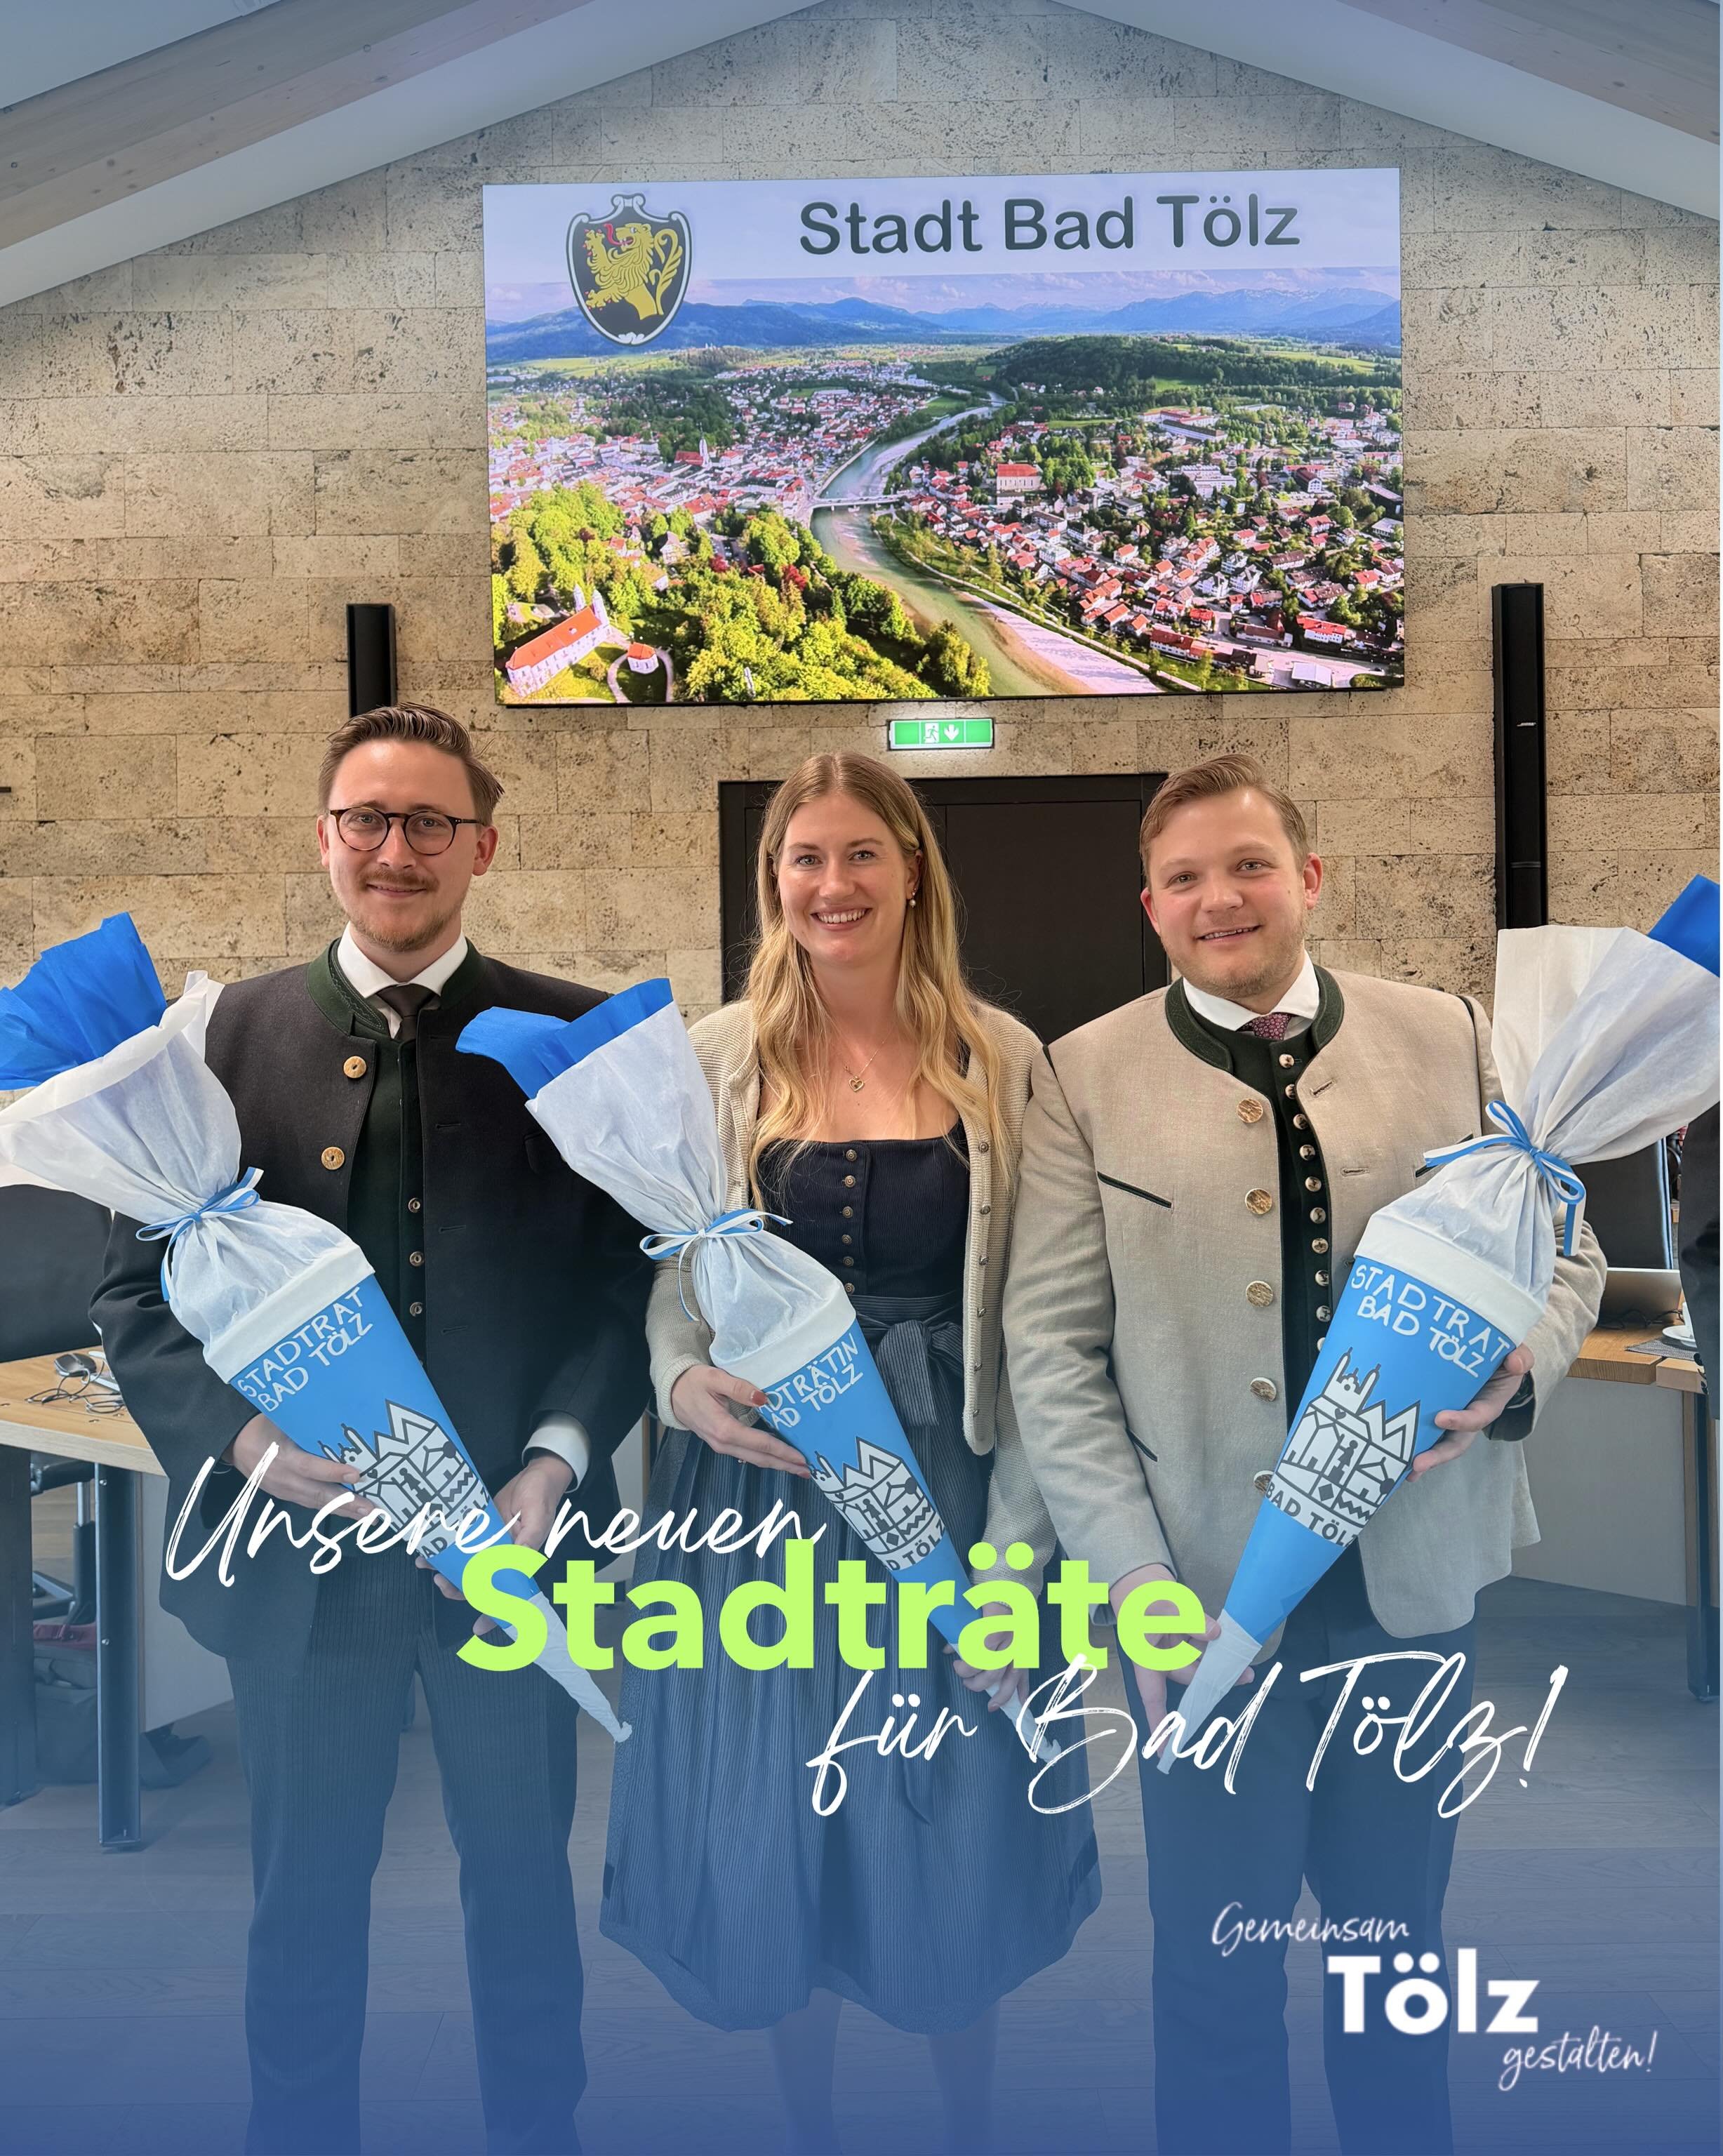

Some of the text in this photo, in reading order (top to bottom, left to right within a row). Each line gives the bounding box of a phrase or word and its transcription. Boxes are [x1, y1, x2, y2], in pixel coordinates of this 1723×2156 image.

[799, 193, 1300, 255] Stadt Bad Tölz
[237, 1286, 364, 1397] STADTRAT
[1351, 1264, 1510, 1363] STADTRAT
[1357, 1296, 1486, 1378] BAD TÖLZ
[257, 1312, 373, 1412] BAD TÖLZ
[771, 1363, 863, 1431] AD TÖLZ
[1266, 1482, 1301, 1517] BAD
